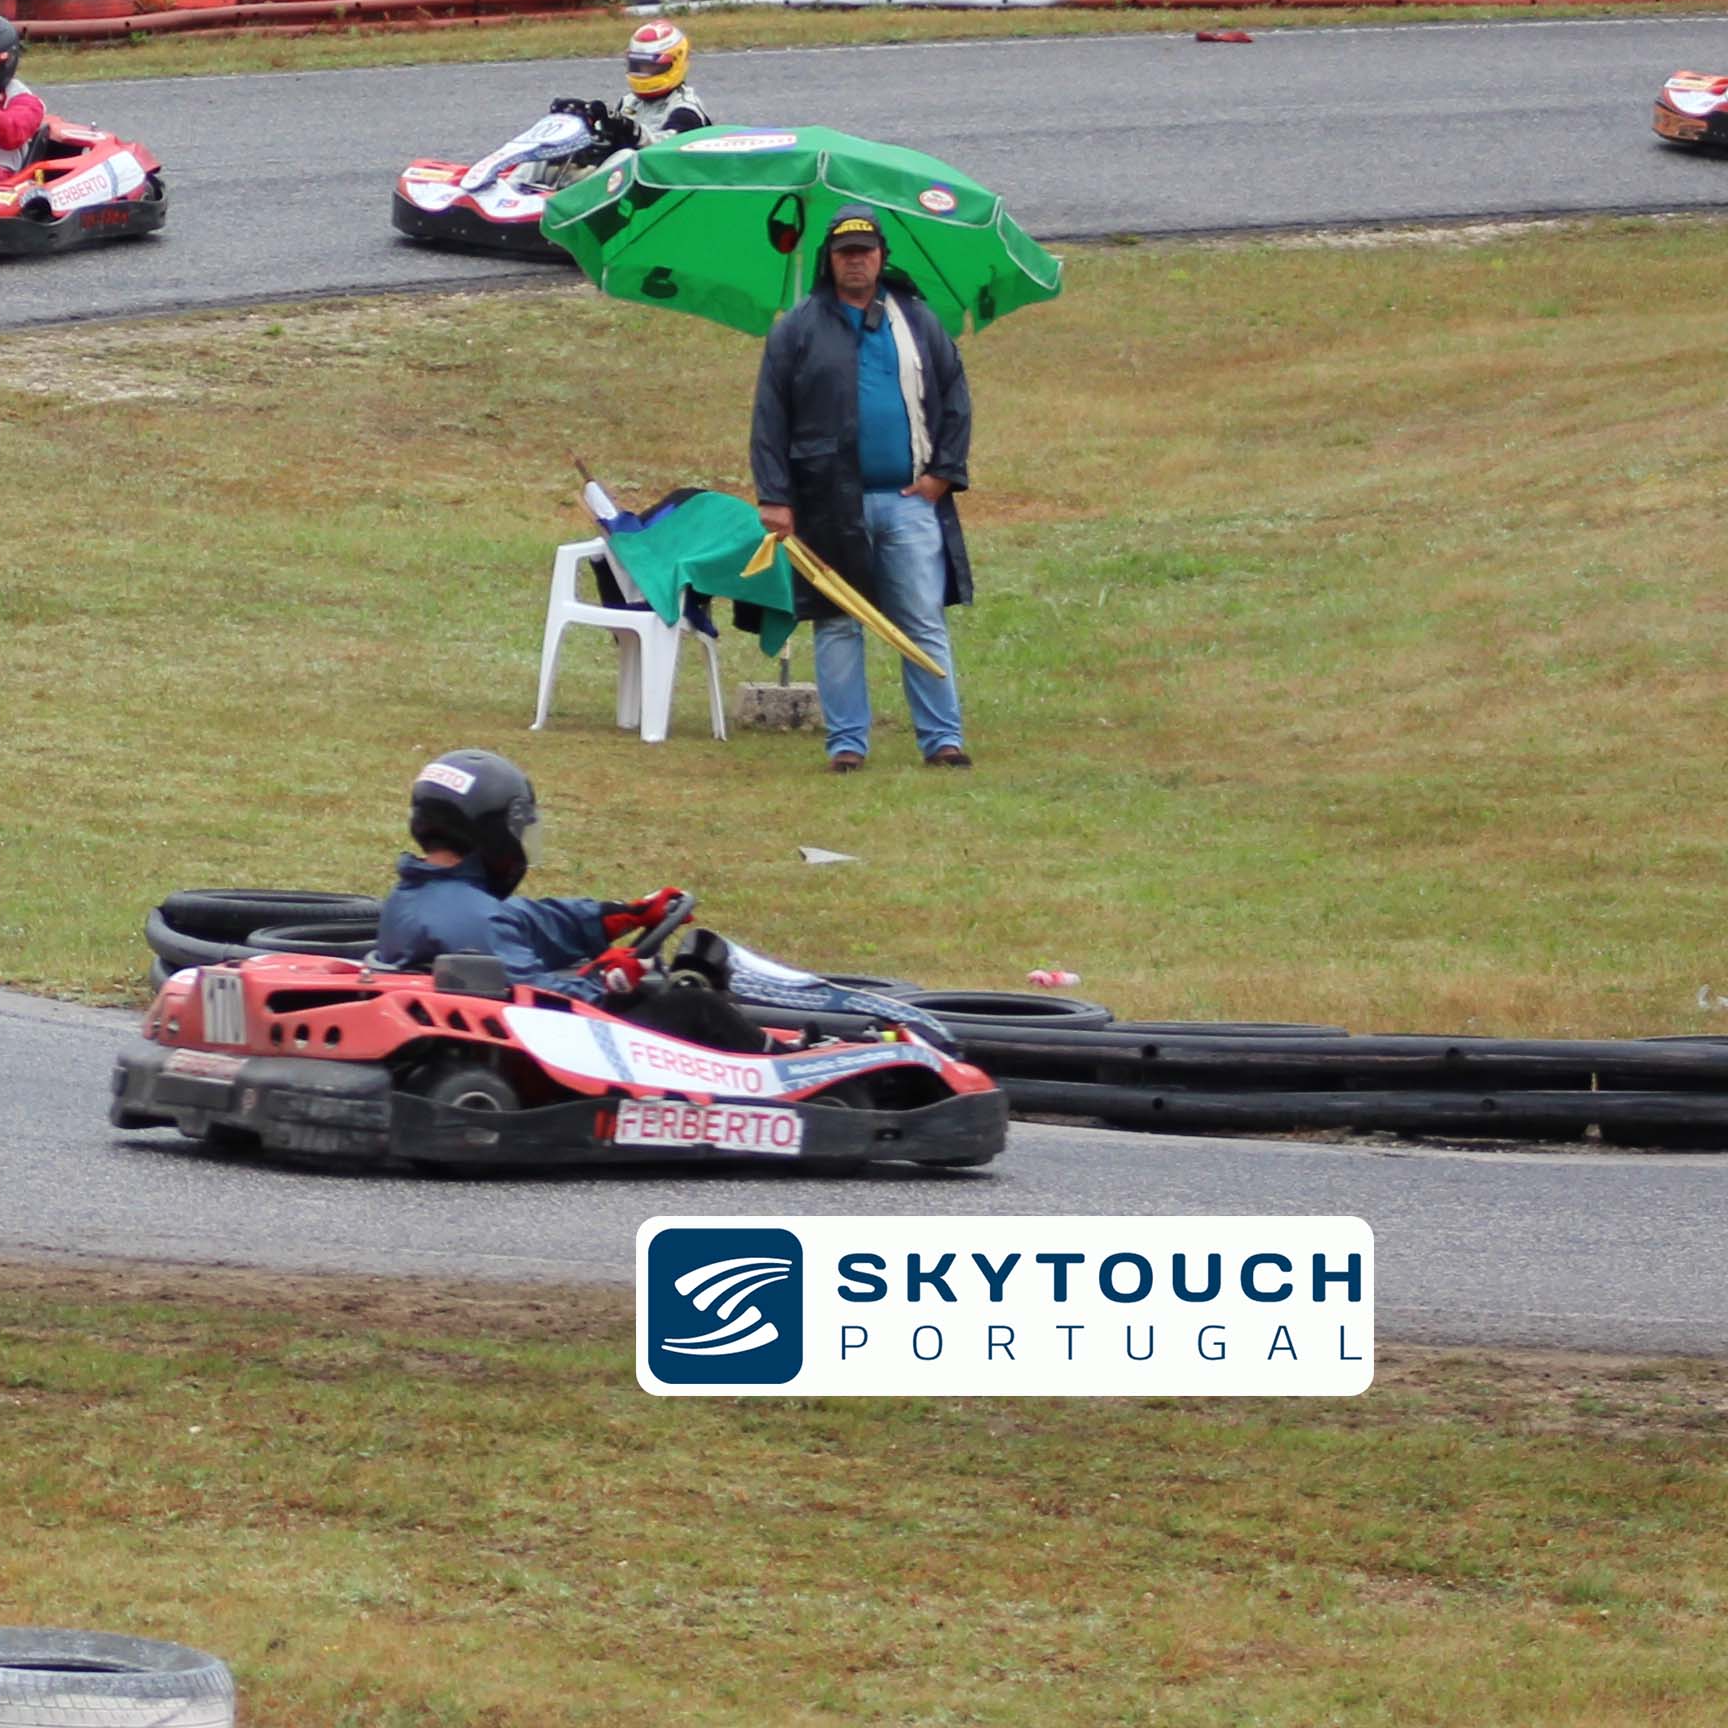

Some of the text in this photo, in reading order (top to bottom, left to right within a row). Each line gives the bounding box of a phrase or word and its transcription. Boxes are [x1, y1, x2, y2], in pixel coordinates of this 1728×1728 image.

[52, 174, 108, 208] FERBERTO
[629, 1041, 763, 1094] FERBERTO
[622, 1106, 794, 1147] FERBERTO
